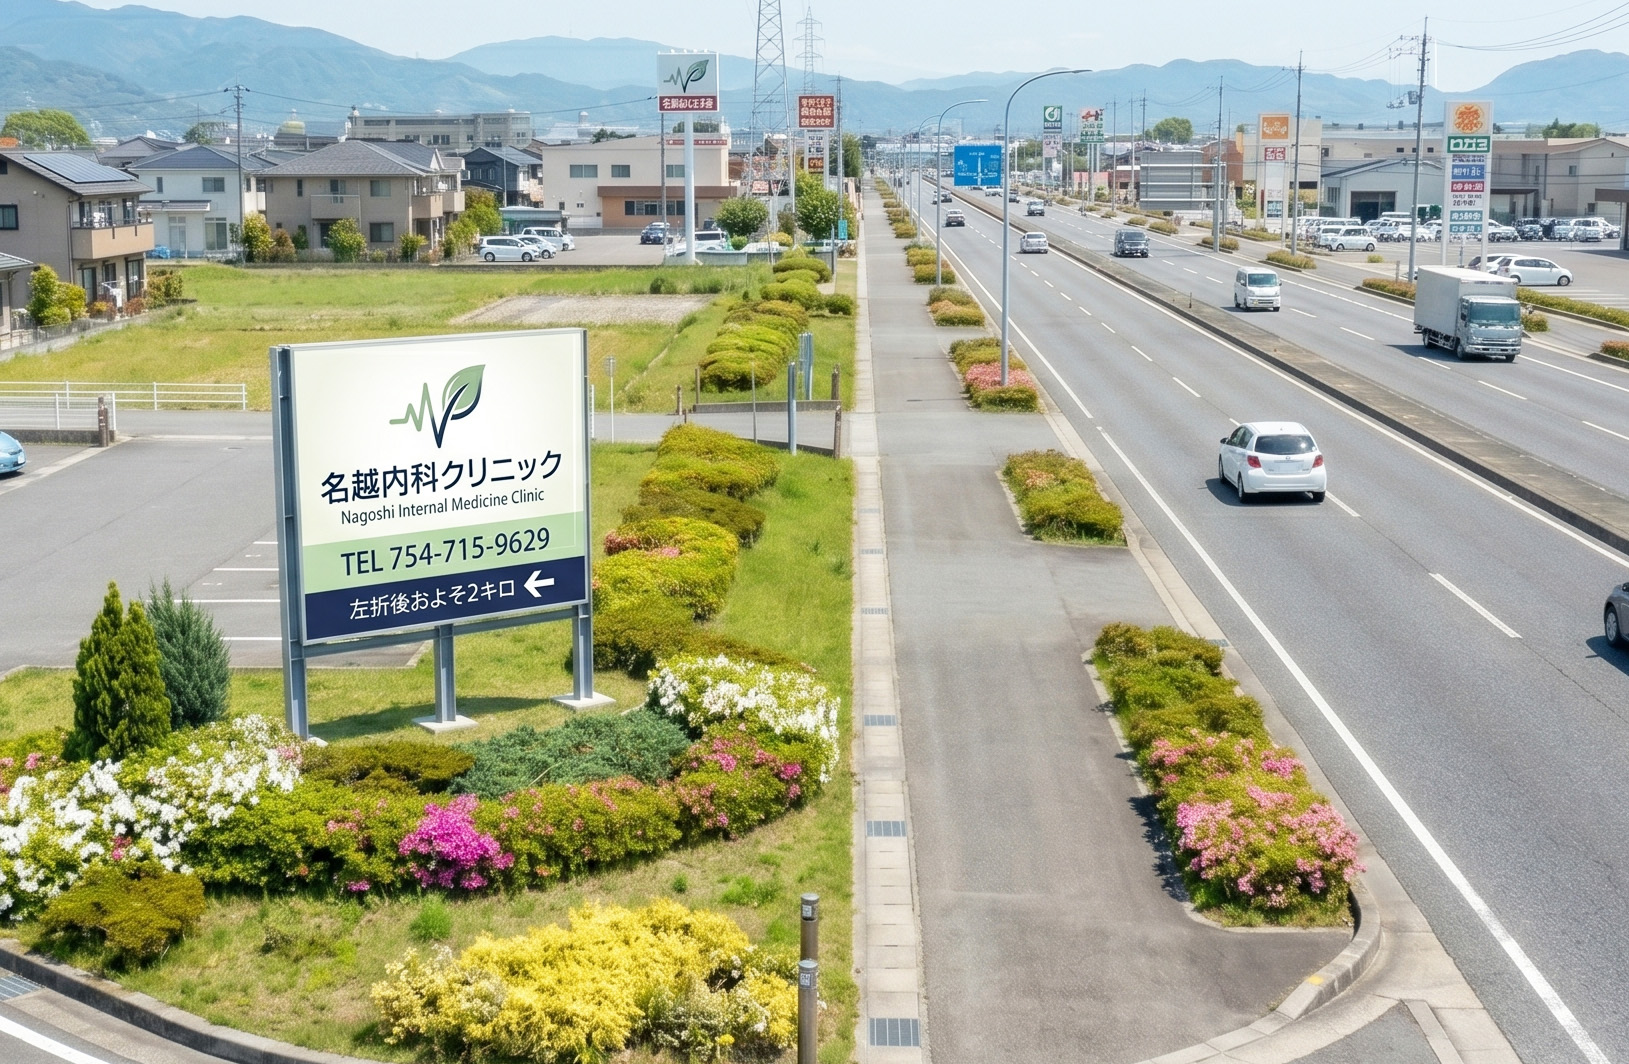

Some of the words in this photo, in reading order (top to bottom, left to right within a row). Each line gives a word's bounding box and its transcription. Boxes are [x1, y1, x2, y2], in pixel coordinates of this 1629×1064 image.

[320, 450, 562, 504] 名越内科クリニック
[341, 504, 395, 526] Nagoshi
[399, 497, 448, 518] Internal
[452, 492, 508, 511] Medicine
[511, 487, 545, 504] Clinic
[340, 549, 383, 576] TEL
[390, 527, 550, 571] 754-715-9629
[350, 580, 515, 620] 左折後およそ2キロ
